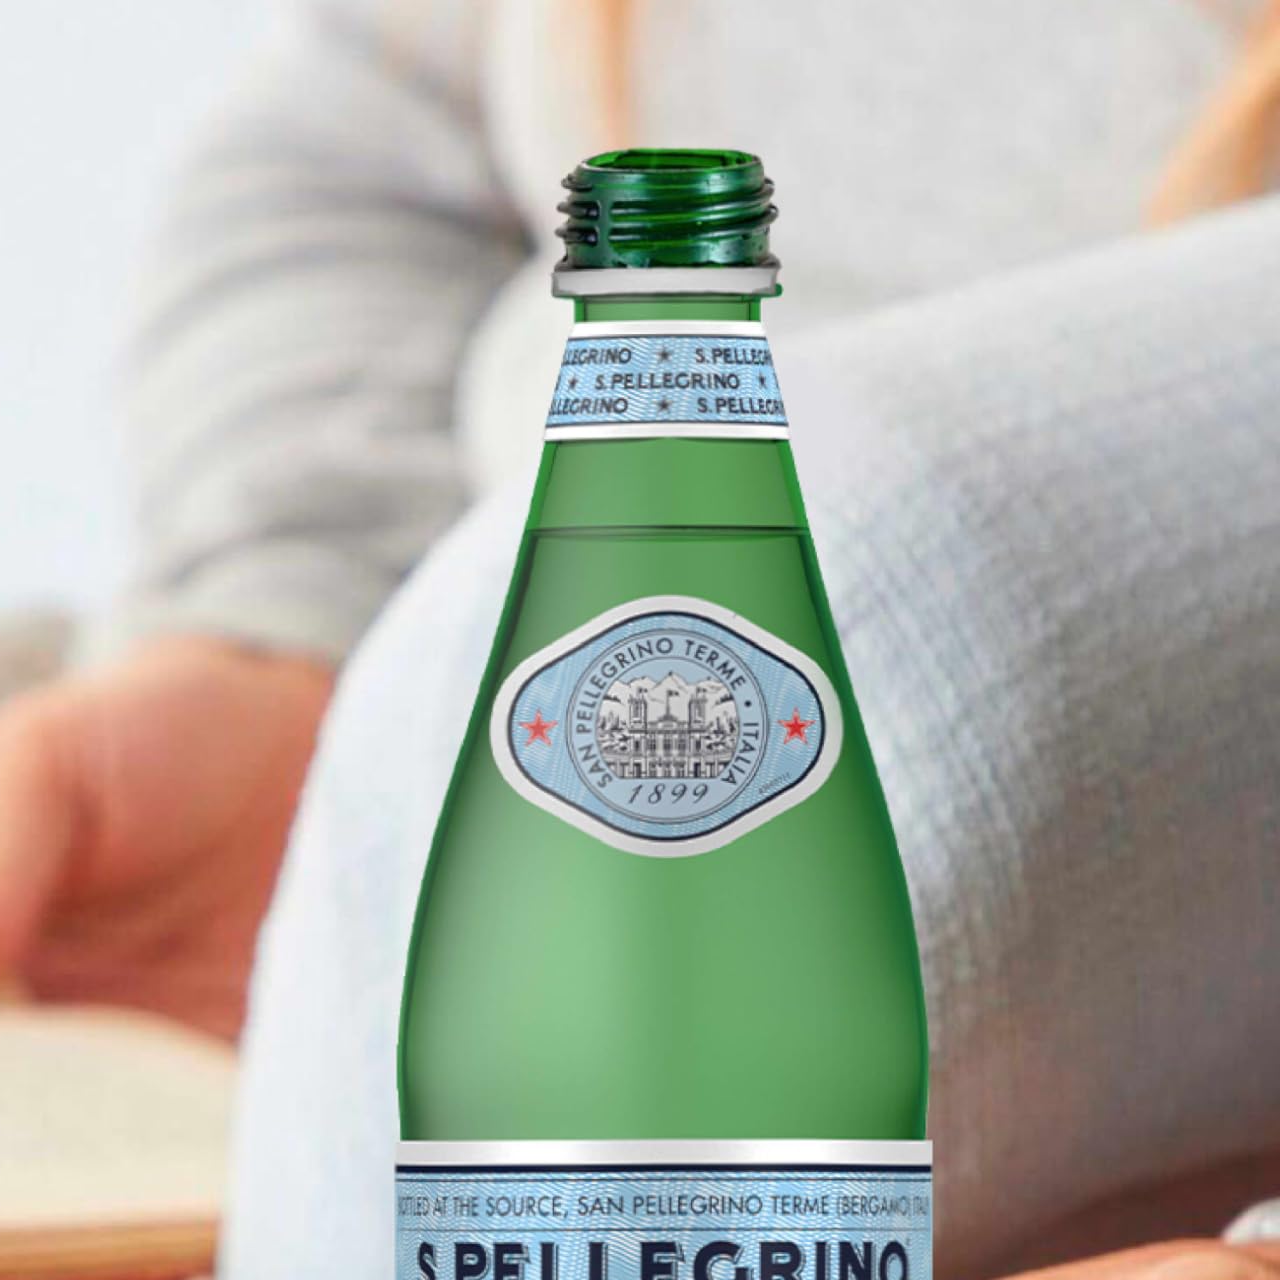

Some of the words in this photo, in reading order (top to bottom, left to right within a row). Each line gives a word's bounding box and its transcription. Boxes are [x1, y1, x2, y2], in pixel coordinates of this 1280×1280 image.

[575, 636, 674, 734] PELLEGRINO
[684, 639, 746, 689] TERME
[579, 748, 613, 789] SAN
[719, 721, 759, 787] ITALIA
[627, 782, 709, 805] 1899
[453, 1196, 479, 1216] THE
[485, 1195, 569, 1219] SOURCE,
[577, 1195, 624, 1216] SAN
[633, 1194, 763, 1216] PELLEGRINO
[772, 1194, 829, 1216] TERME
